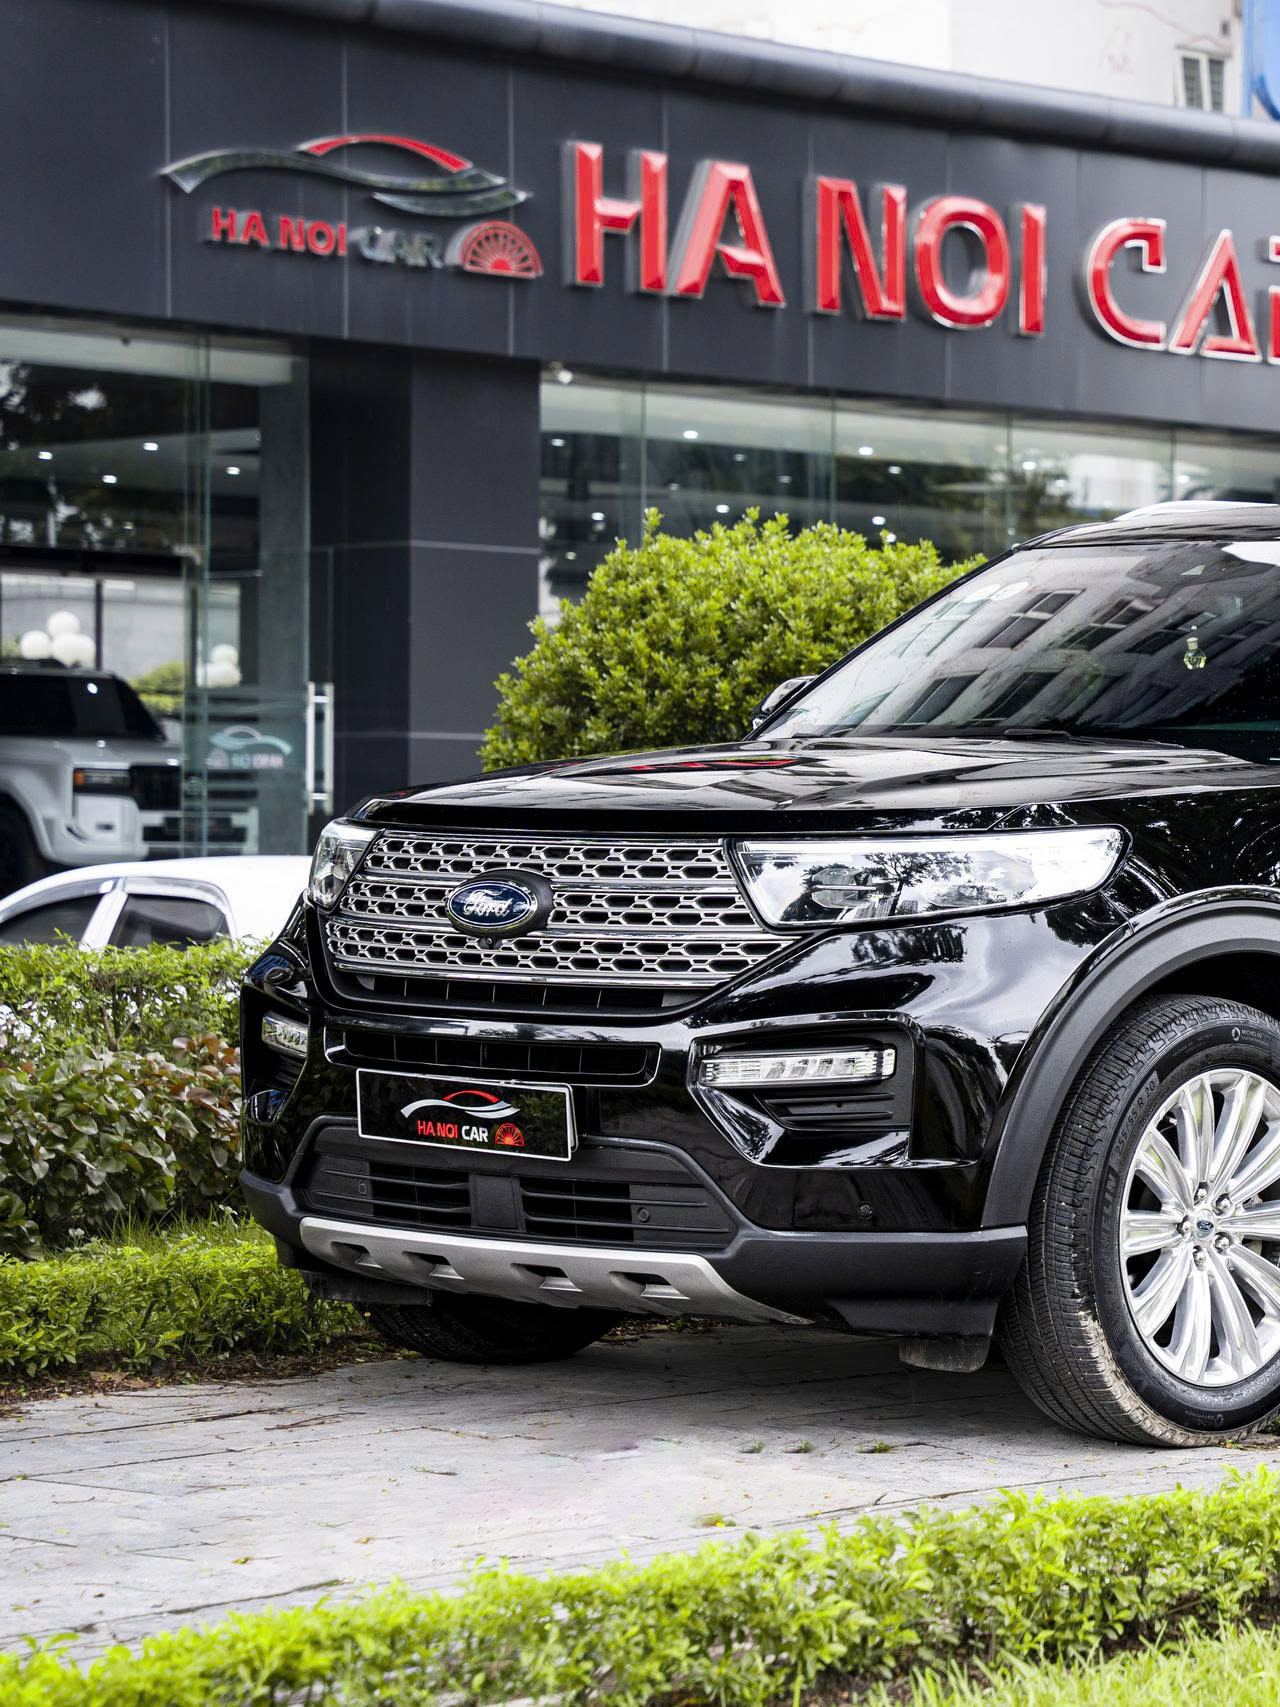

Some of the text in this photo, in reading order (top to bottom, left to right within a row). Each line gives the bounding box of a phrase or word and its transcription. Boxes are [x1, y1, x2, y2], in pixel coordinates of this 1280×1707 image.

[211, 207, 444, 268] HA NOI CAR
[569, 139, 786, 308] HA
[815, 176, 1046, 337] NOI
[463, 889, 514, 917] Ford
[461, 1125, 489, 1143] CAR
